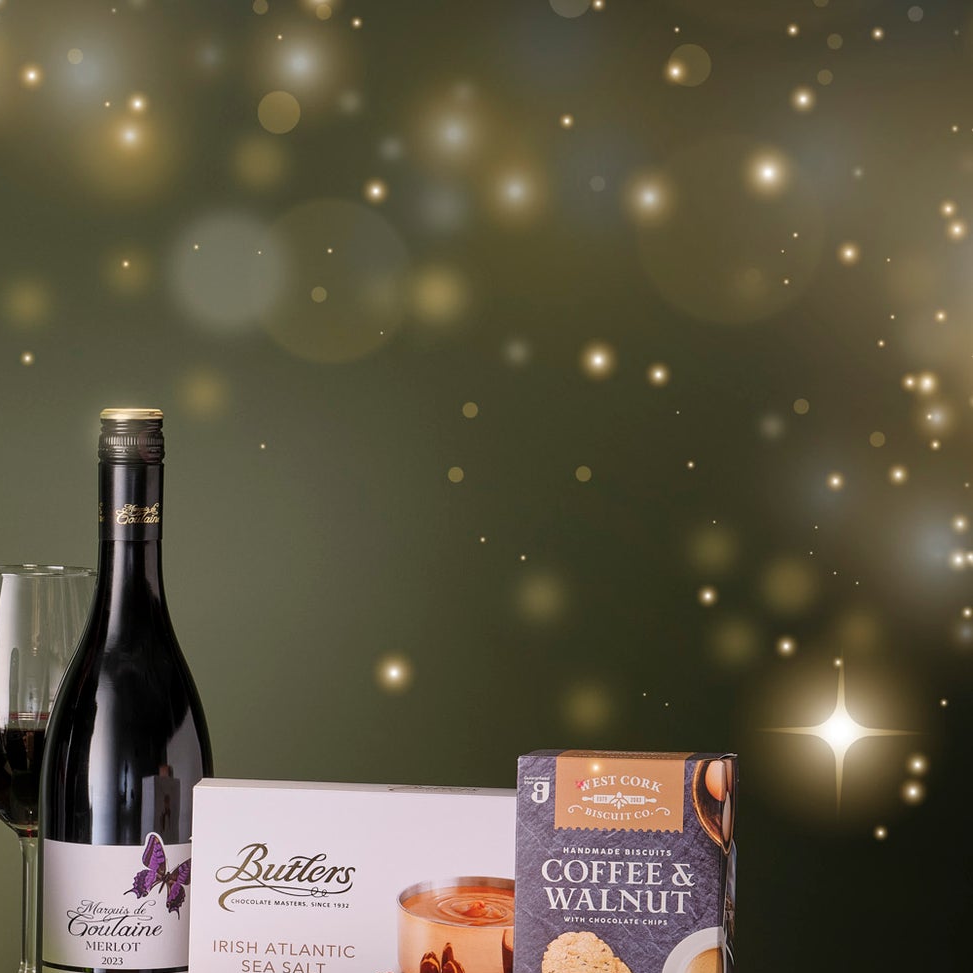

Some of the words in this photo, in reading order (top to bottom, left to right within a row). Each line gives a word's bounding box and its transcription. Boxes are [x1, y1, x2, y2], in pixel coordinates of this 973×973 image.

[580, 775, 617, 792] WEST
[621, 775, 664, 793] CORK
[585, 807, 631, 821] BISCUIT
[563, 847, 620, 855] HANDMADE
[625, 848, 672, 857] BISCUITS
[215, 842, 356, 888] Butlers
[541, 859, 663, 886] COFFEE
[671, 863, 695, 887] &
[231, 898, 272, 906] CHOCOLATE
[543, 887, 692, 914] WALNUT
[77, 899, 130, 918] Marquis
[134, 900, 156, 915] de
[589, 917, 639, 925] CHOCOLATE
[86, 941, 141, 952] MERLOT
[213, 940, 258, 954] IRISH
[265, 942, 356, 959] ATLANTIC
[101, 957, 124, 966] 2023
[241, 960, 276, 973] SEA
